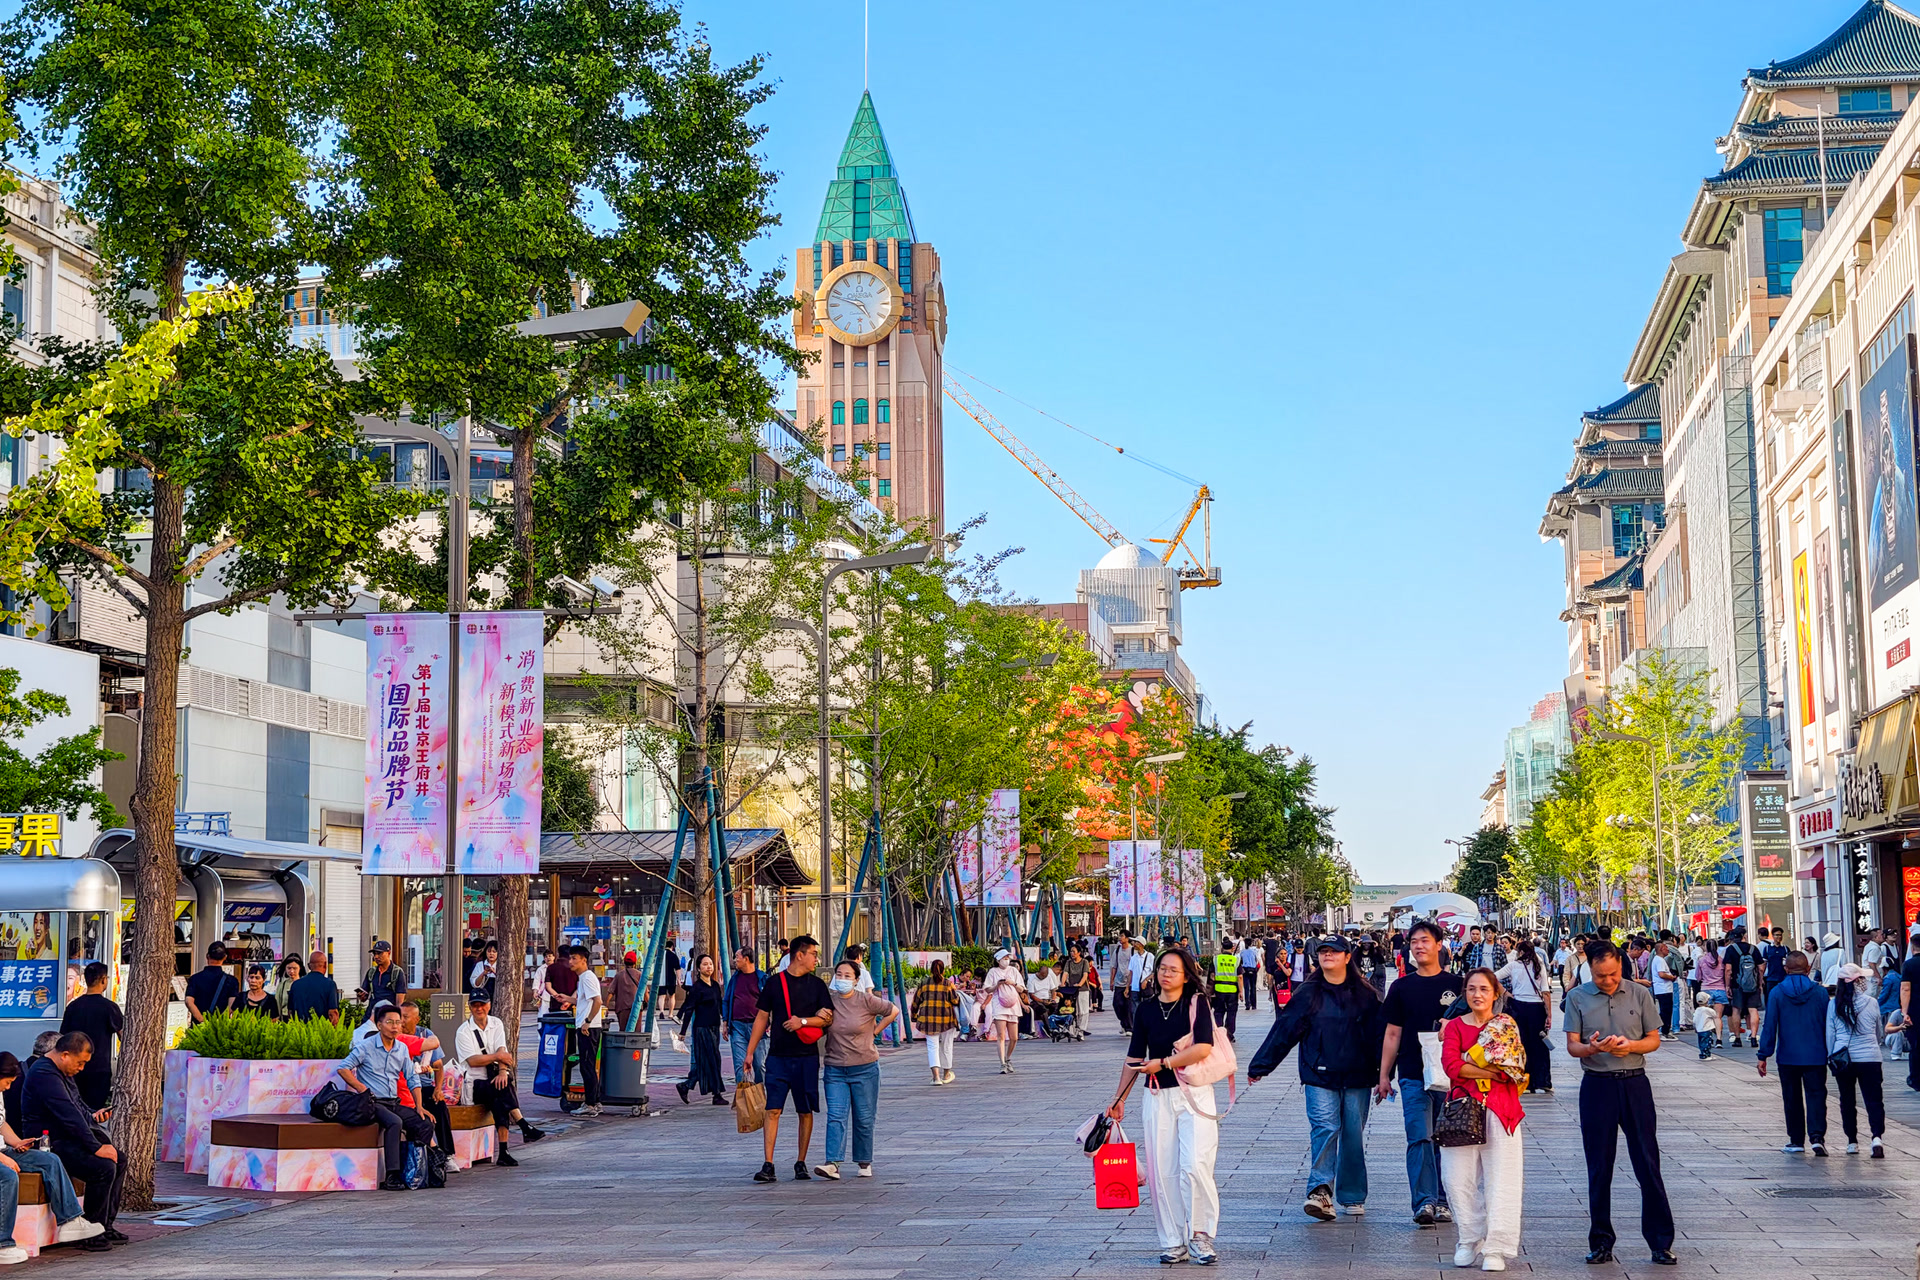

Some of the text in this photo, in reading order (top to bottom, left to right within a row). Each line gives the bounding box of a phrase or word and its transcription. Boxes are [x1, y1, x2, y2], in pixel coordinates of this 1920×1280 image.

[382, 683, 413, 811] 国际品牌节
[412, 664, 432, 797] 第十届北京王府井
[497, 682, 518, 799] 新模式新场景
[516, 650, 537, 755] 消费新业态
[0, 965, 53, 983] 事在手
